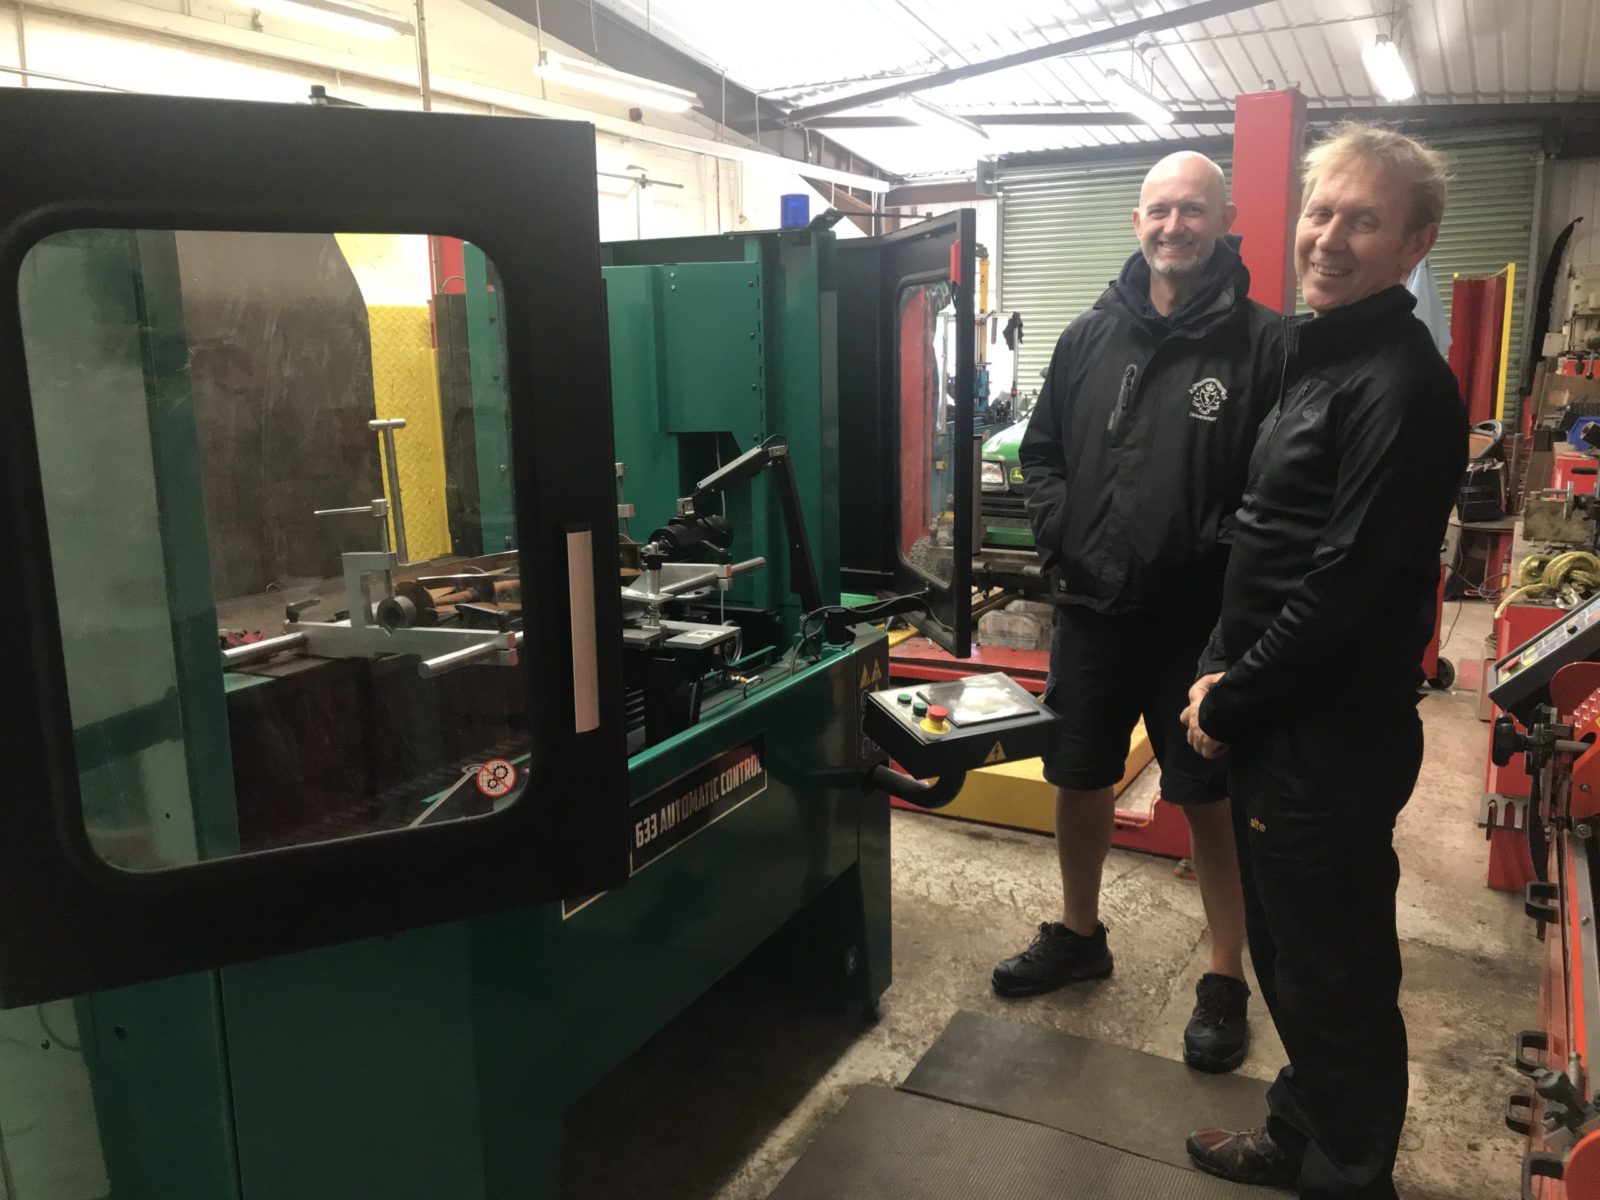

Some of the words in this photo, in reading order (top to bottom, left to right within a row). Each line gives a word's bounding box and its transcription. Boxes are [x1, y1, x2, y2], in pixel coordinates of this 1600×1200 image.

[635, 813, 658, 848] 633
[660, 777, 719, 834] AUTOMATIC
[720, 753, 763, 796] CONTROL
